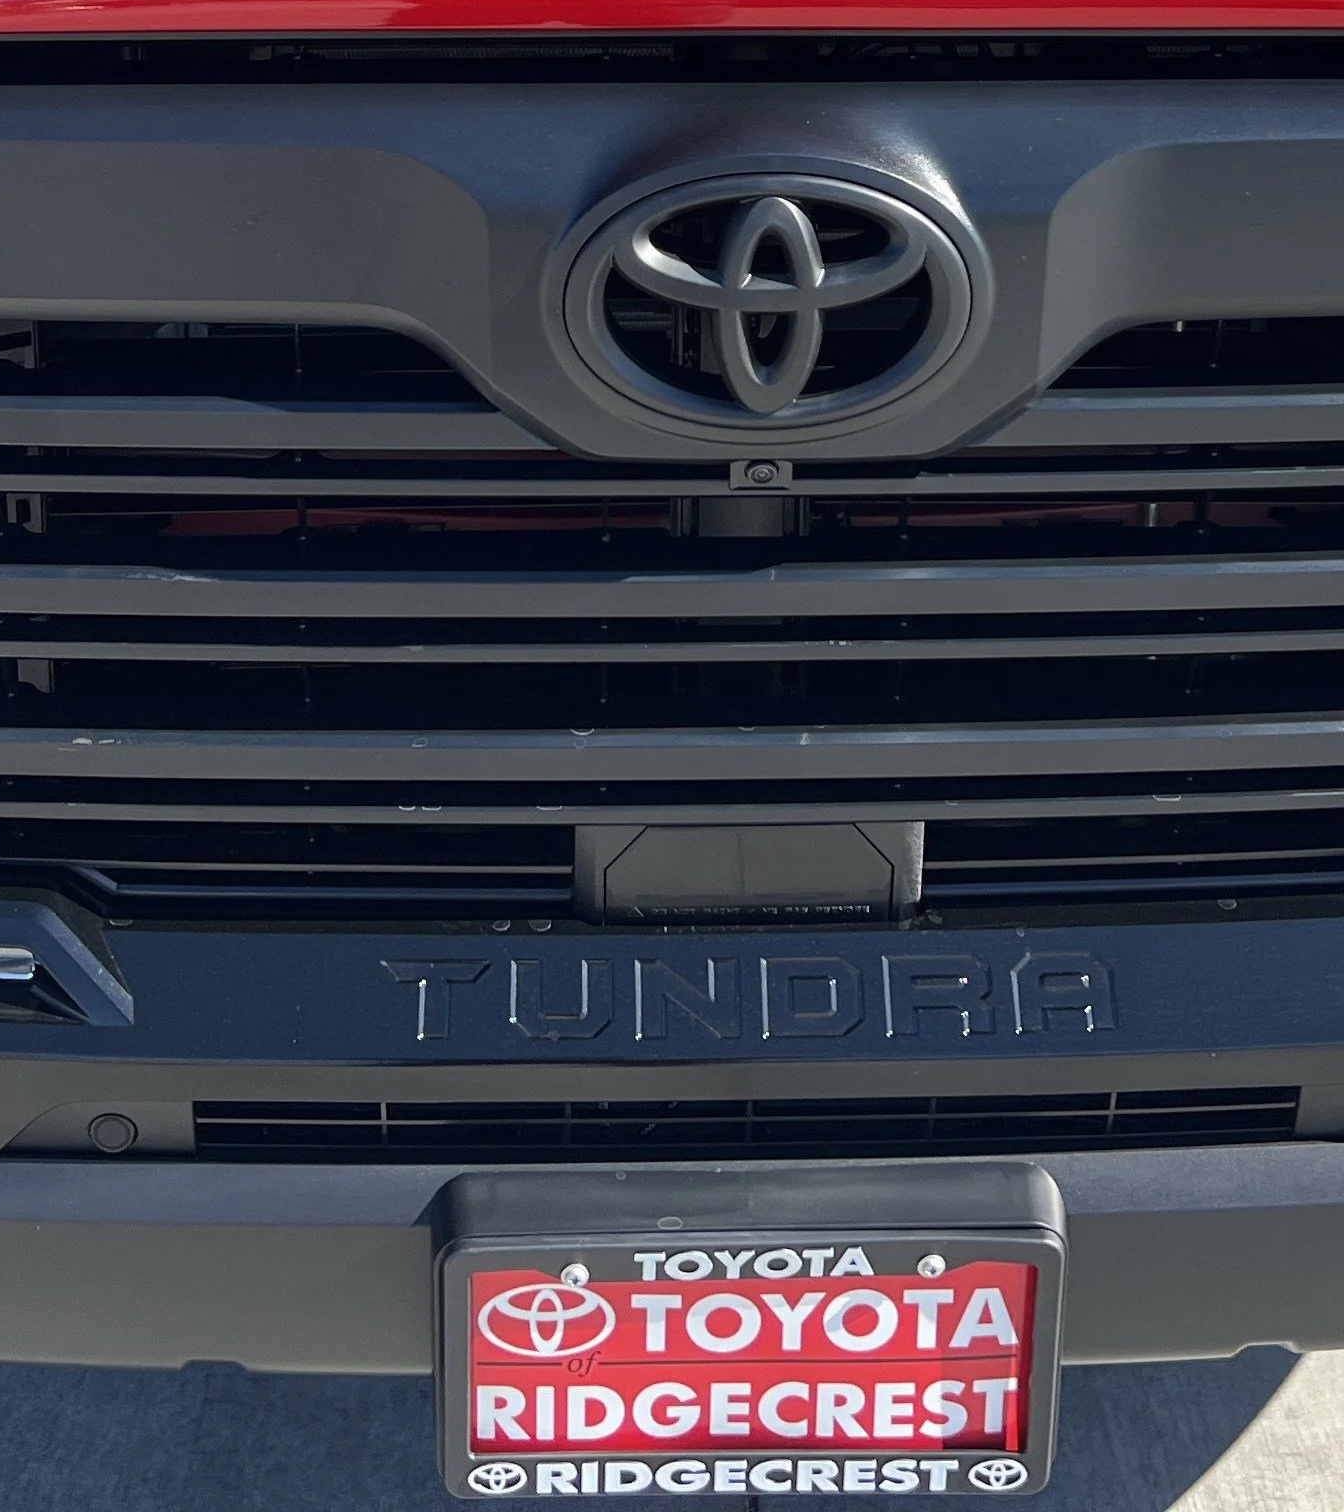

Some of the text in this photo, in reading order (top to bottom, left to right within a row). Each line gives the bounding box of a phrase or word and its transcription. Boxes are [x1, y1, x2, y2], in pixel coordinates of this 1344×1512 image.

[380, 950, 1117, 1041] TUNDRA
[634, 1246, 874, 1281] TOYOTA
[631, 1288, 1019, 1353] TOYOTA
[566, 1351, 601, 1377] of
[476, 1377, 1018, 1442] RIDGECREST
[535, 1458, 960, 1495] RIDGECREST
